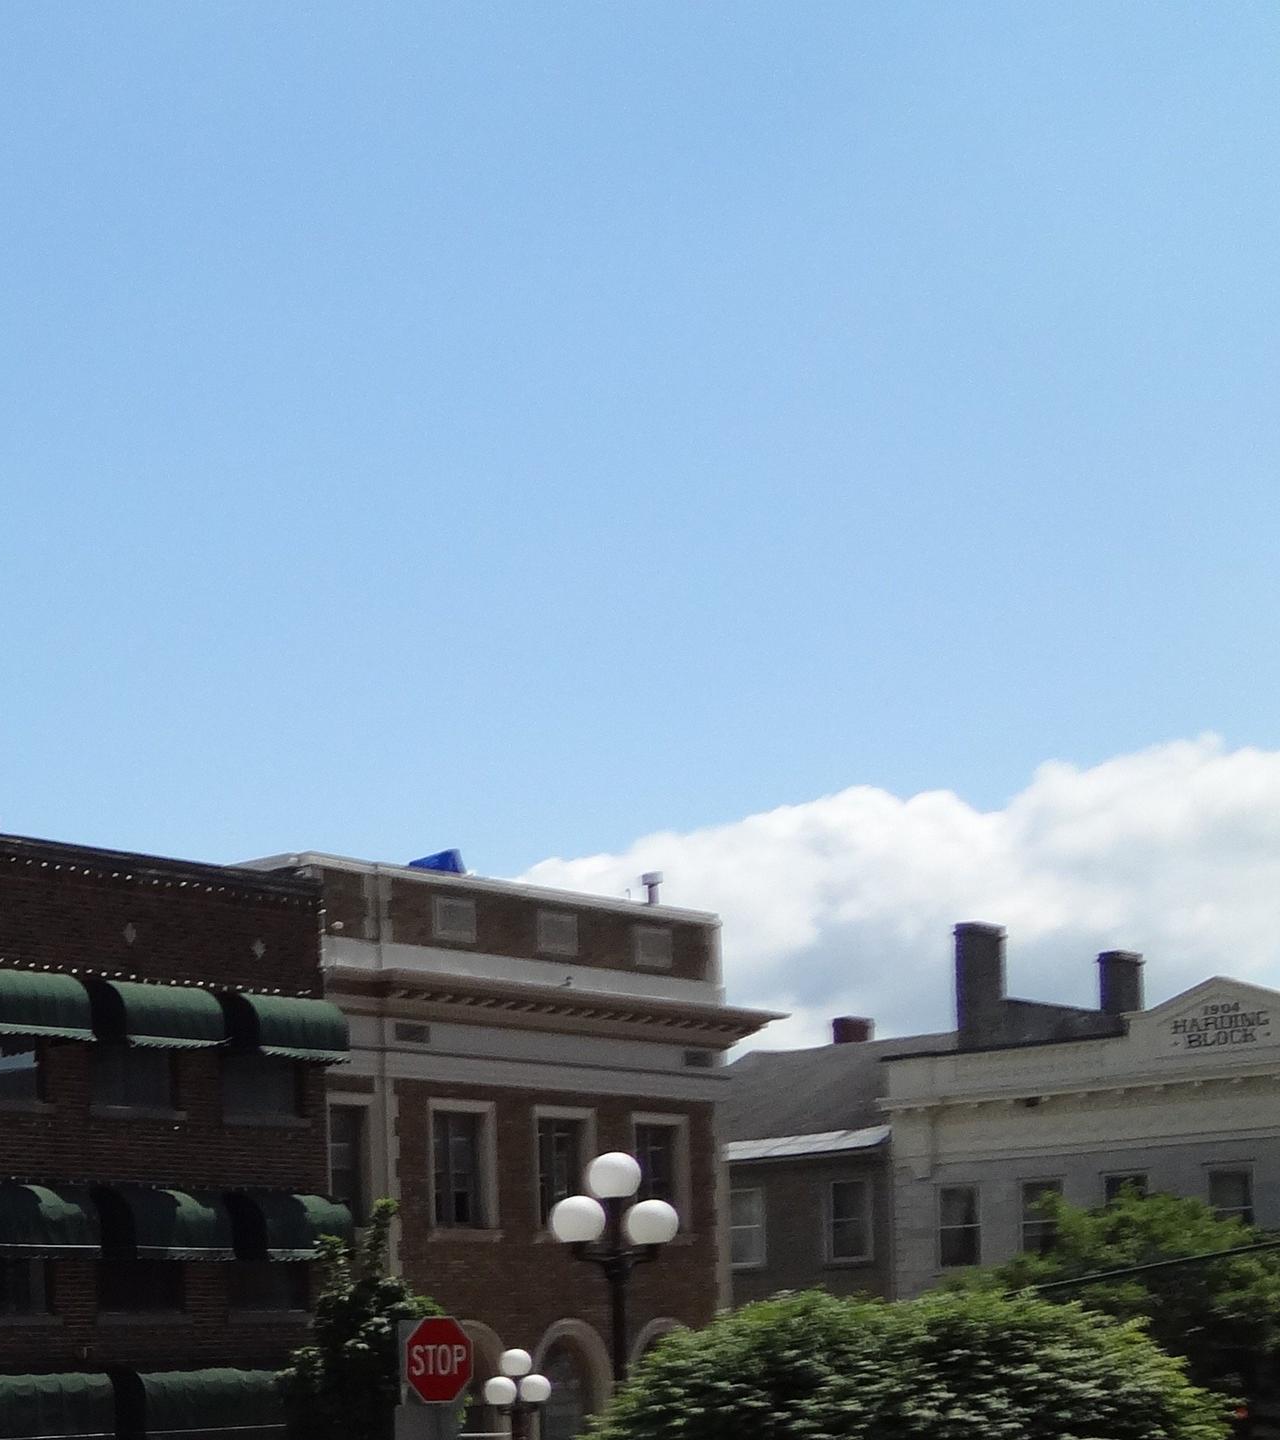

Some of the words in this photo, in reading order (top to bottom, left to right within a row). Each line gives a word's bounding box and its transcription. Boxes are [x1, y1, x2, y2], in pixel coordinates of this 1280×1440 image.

[1203, 1002, 1240, 1015] 1904
[1171, 1010, 1270, 1034] HARDING
[1184, 1028, 1257, 1049] BLOCK
[411, 1344, 467, 1376] STOP
